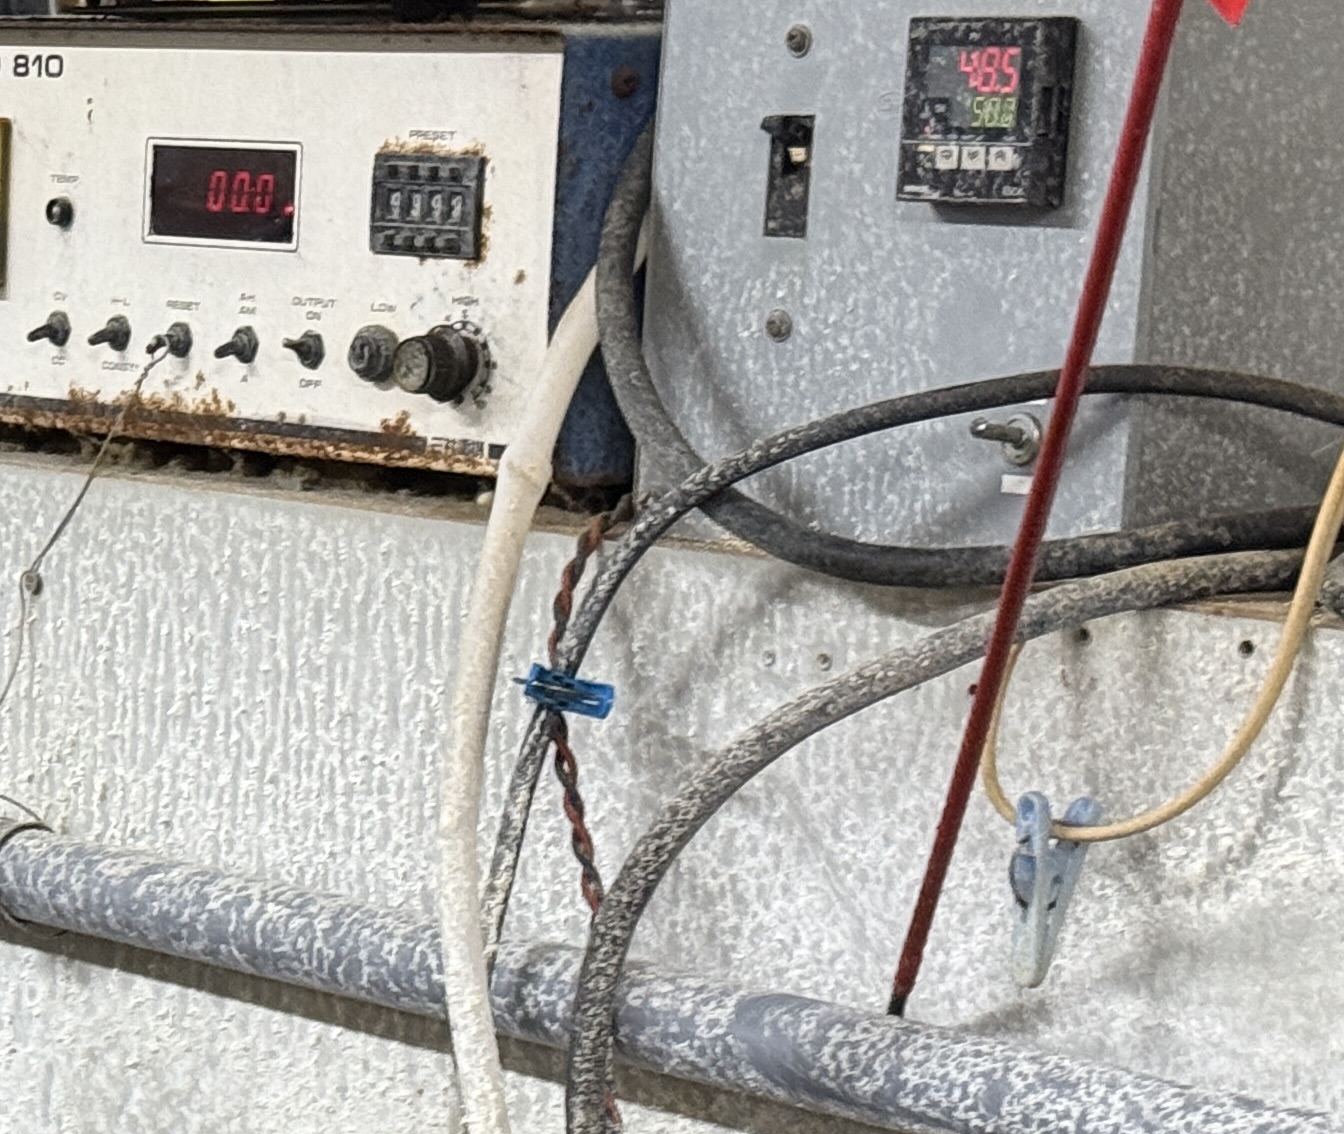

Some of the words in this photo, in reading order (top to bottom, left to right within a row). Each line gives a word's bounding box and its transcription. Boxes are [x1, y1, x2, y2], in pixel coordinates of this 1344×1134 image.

[13, 54, 64, 78] 810
[409, 130, 457, 141] PRESET
[50, 174, 79, 184] TEMP
[291, 296, 337, 308] OUTPUT
[370, 302, 397, 313] LOW
[298, 377, 323, 389] OFF
